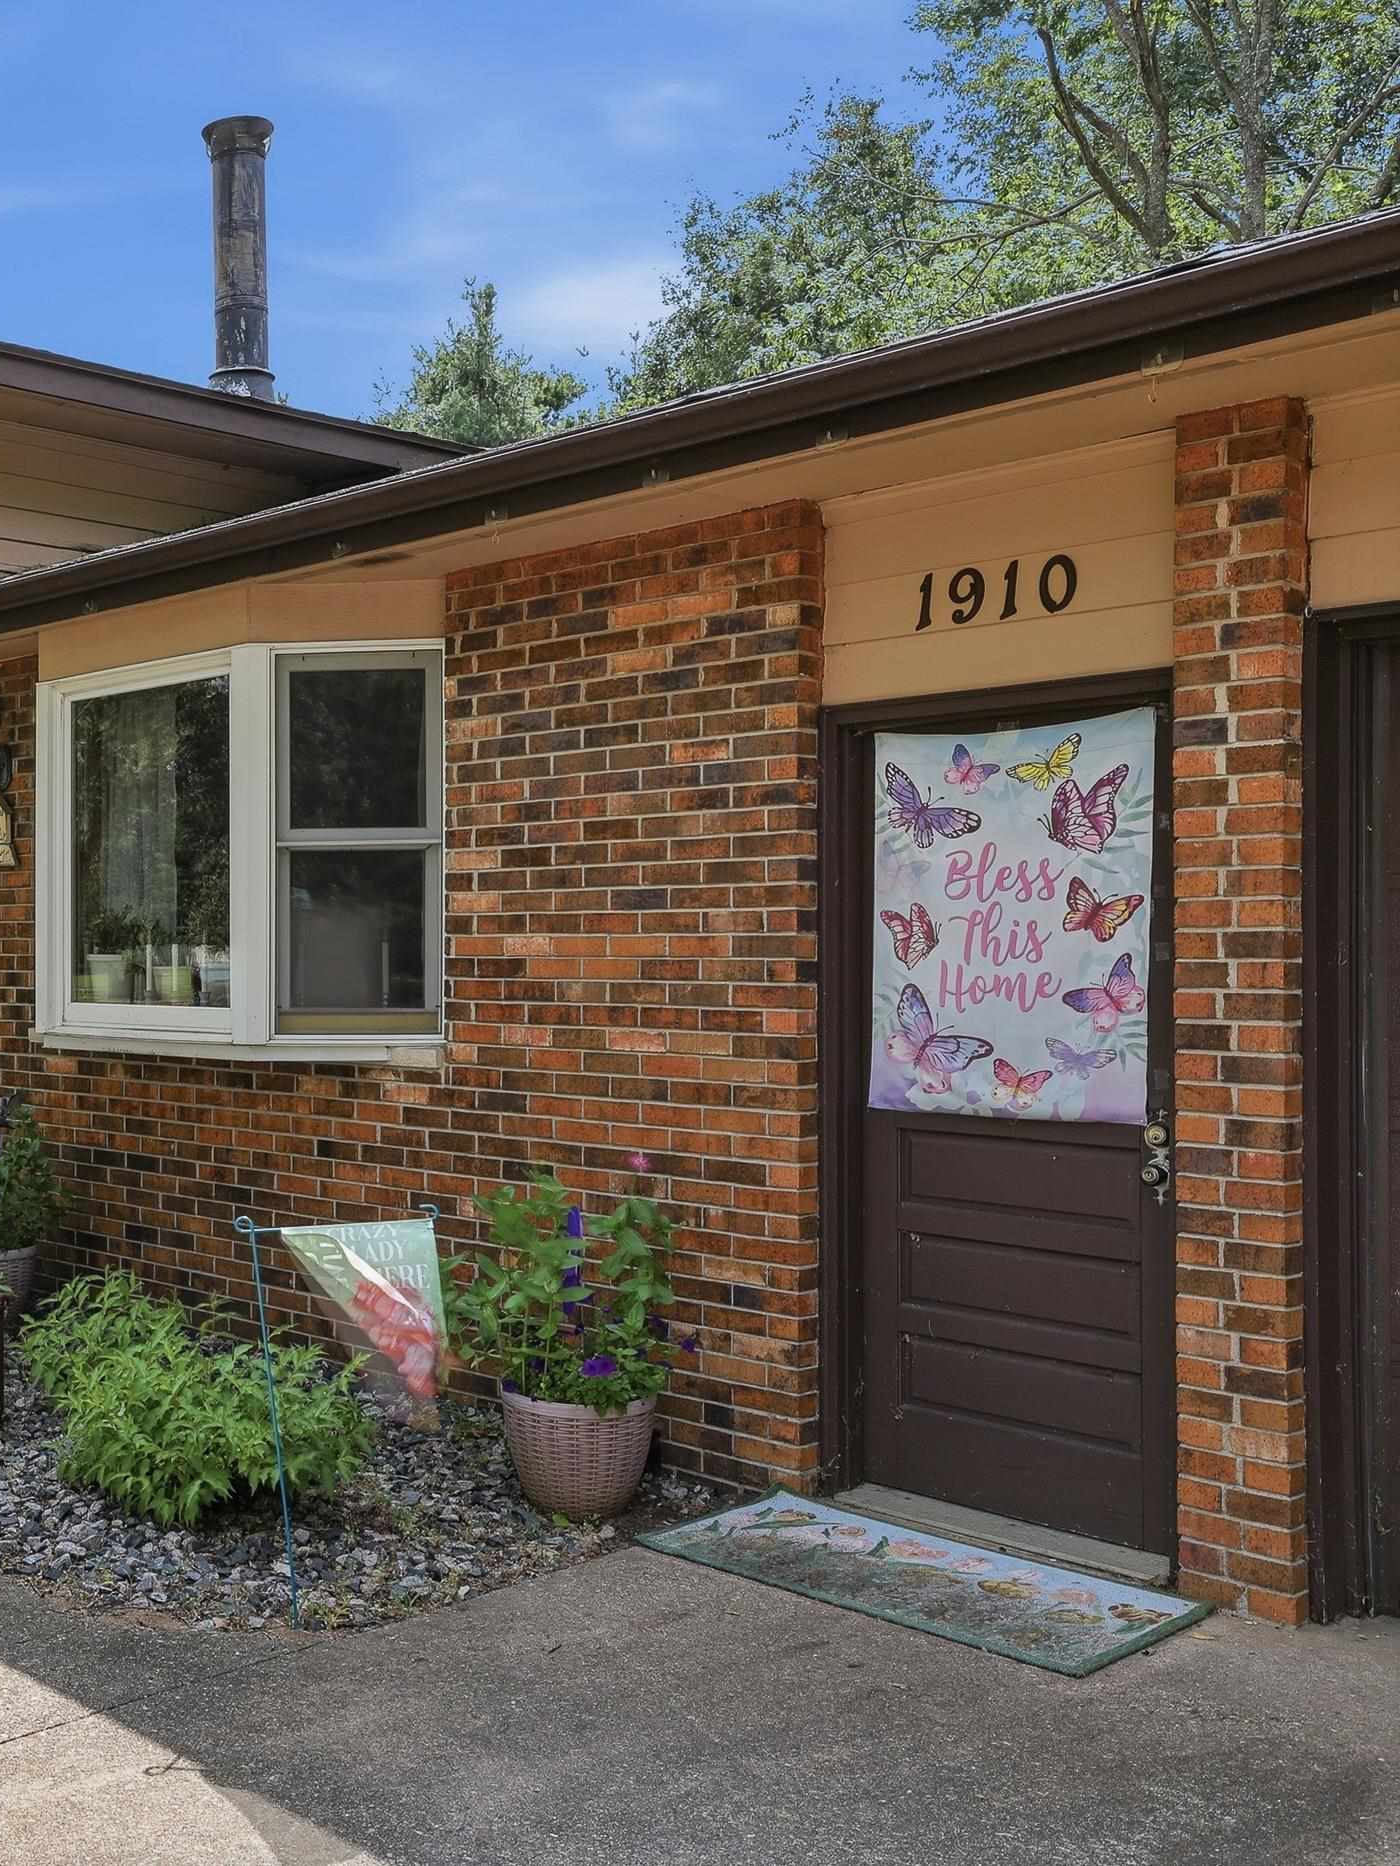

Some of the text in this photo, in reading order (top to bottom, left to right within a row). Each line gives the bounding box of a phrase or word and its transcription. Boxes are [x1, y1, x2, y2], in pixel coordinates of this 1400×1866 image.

[915, 554, 1077, 631] 1910
[945, 842, 1064, 903] Bless
[949, 902, 1052, 966] This
[939, 960, 1062, 1013] Home
